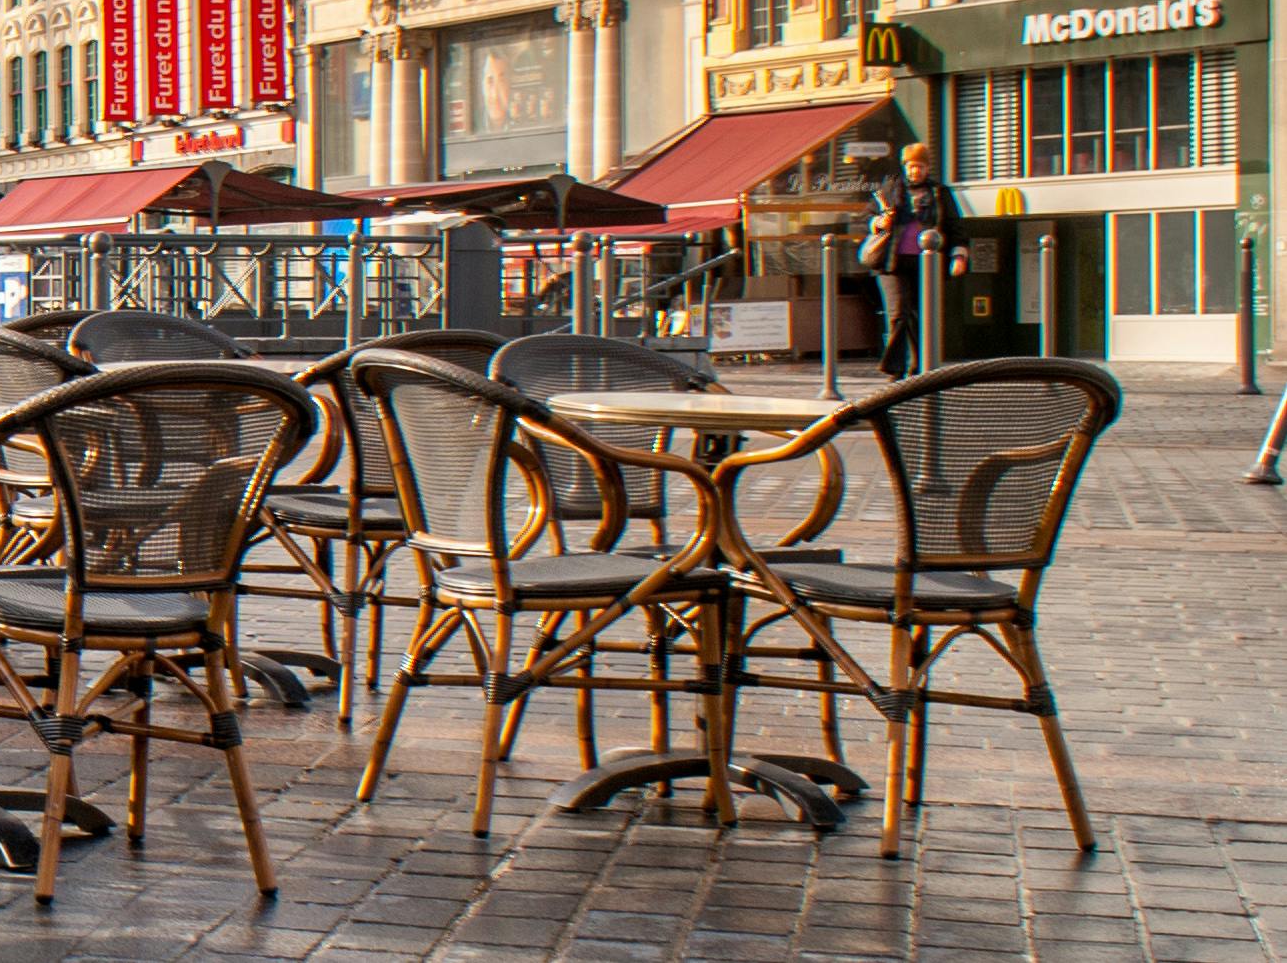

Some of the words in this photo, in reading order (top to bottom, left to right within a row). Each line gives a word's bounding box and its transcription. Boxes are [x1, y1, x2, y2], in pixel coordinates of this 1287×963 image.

[154, 17, 172, 49] du
[207, 9, 226, 39] du
[258, 0, 276, 30] du
[111, 27, 128, 56] du
[154, 51, 173, 109] Furet
[208, 42, 227, 103] Furet
[258, 33, 278, 95] Furet
[110, 60, 128, 115] Furet
